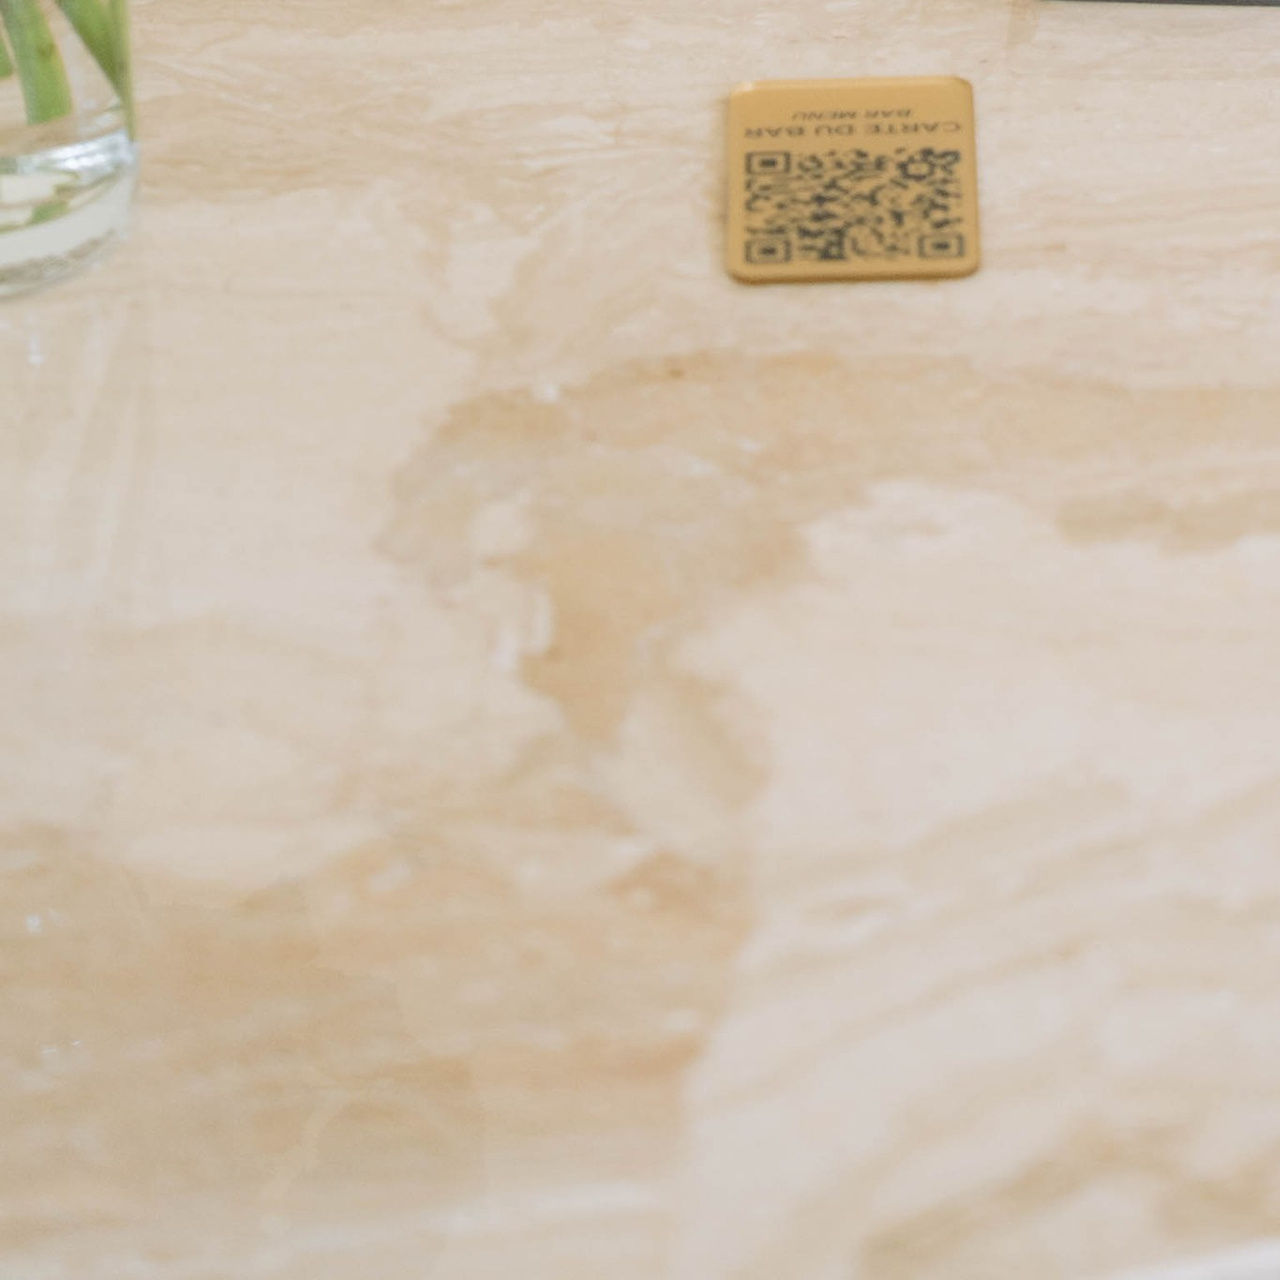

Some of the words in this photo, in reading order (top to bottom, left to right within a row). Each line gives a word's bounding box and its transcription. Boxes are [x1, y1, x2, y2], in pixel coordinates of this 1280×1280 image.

[744, 125, 806, 139] BAR
[814, 124, 855, 136] DU
[865, 121, 961, 136] CARTE
